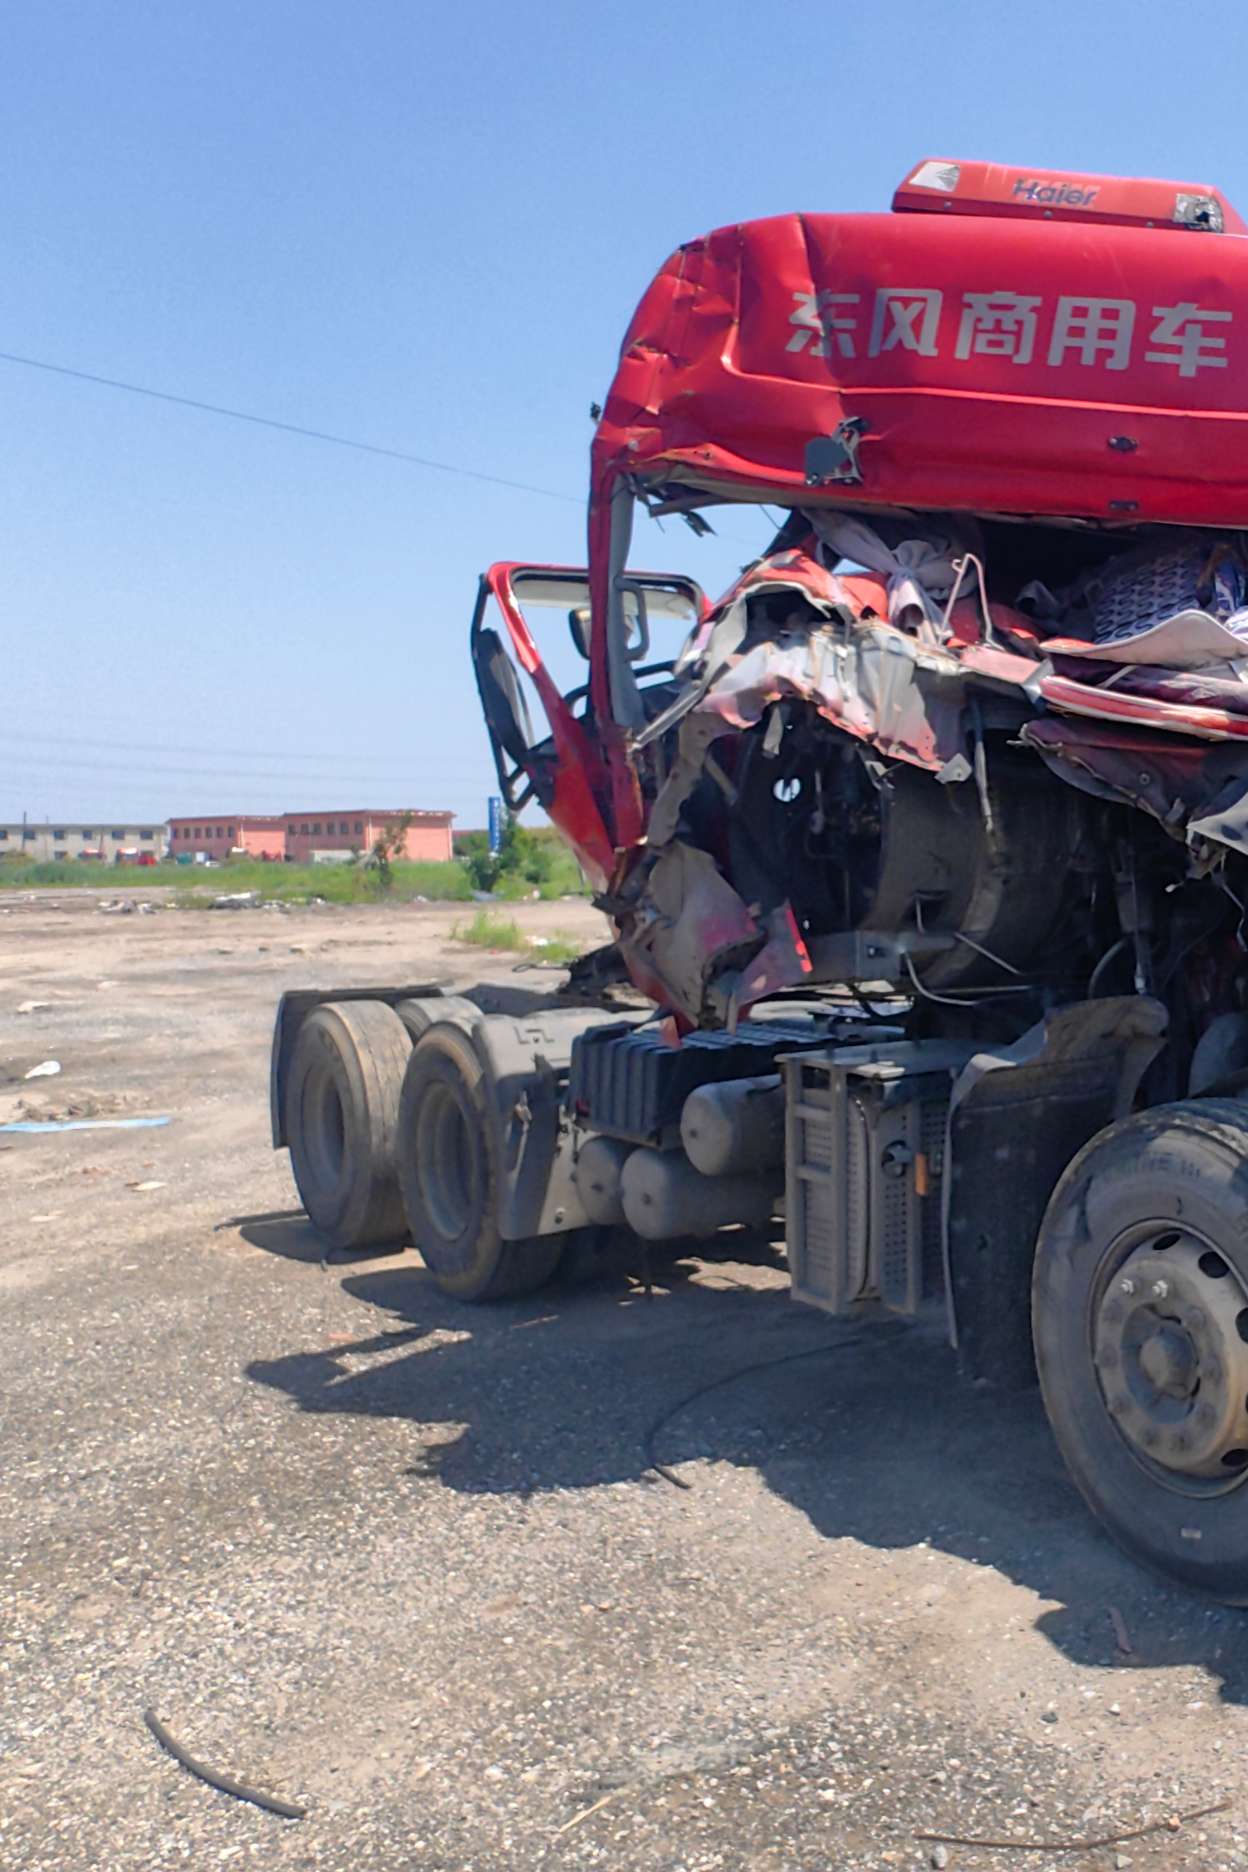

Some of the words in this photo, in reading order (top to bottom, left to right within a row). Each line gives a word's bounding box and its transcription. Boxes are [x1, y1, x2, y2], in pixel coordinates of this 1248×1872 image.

[1013, 177, 1098, 206] Haier
[785, 288, 1233, 377] 东风商用车
